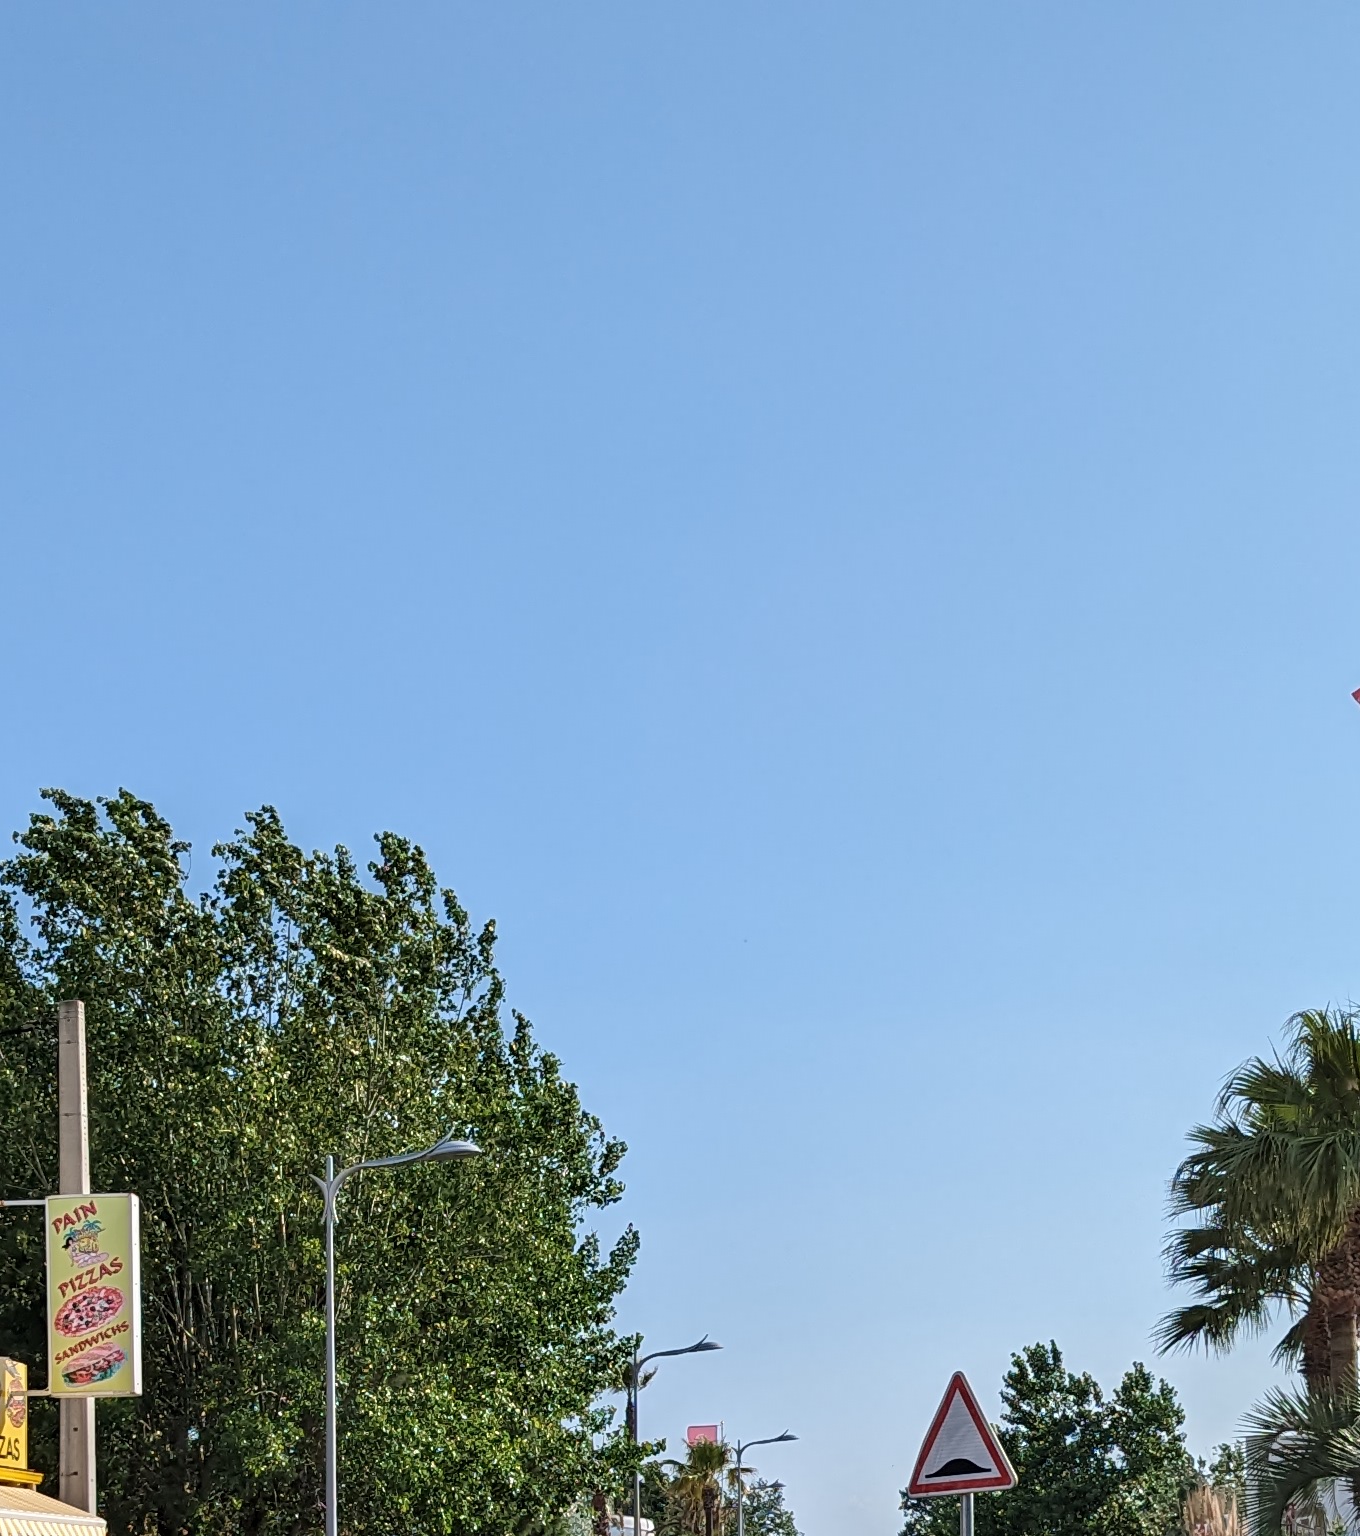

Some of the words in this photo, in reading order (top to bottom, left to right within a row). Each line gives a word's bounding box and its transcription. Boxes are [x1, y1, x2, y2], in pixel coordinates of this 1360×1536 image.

[51, 1200, 99, 1236] PAIN
[57, 1256, 124, 1299] PIZZAS
[54, 1320, 131, 1365] SANDWICHS
